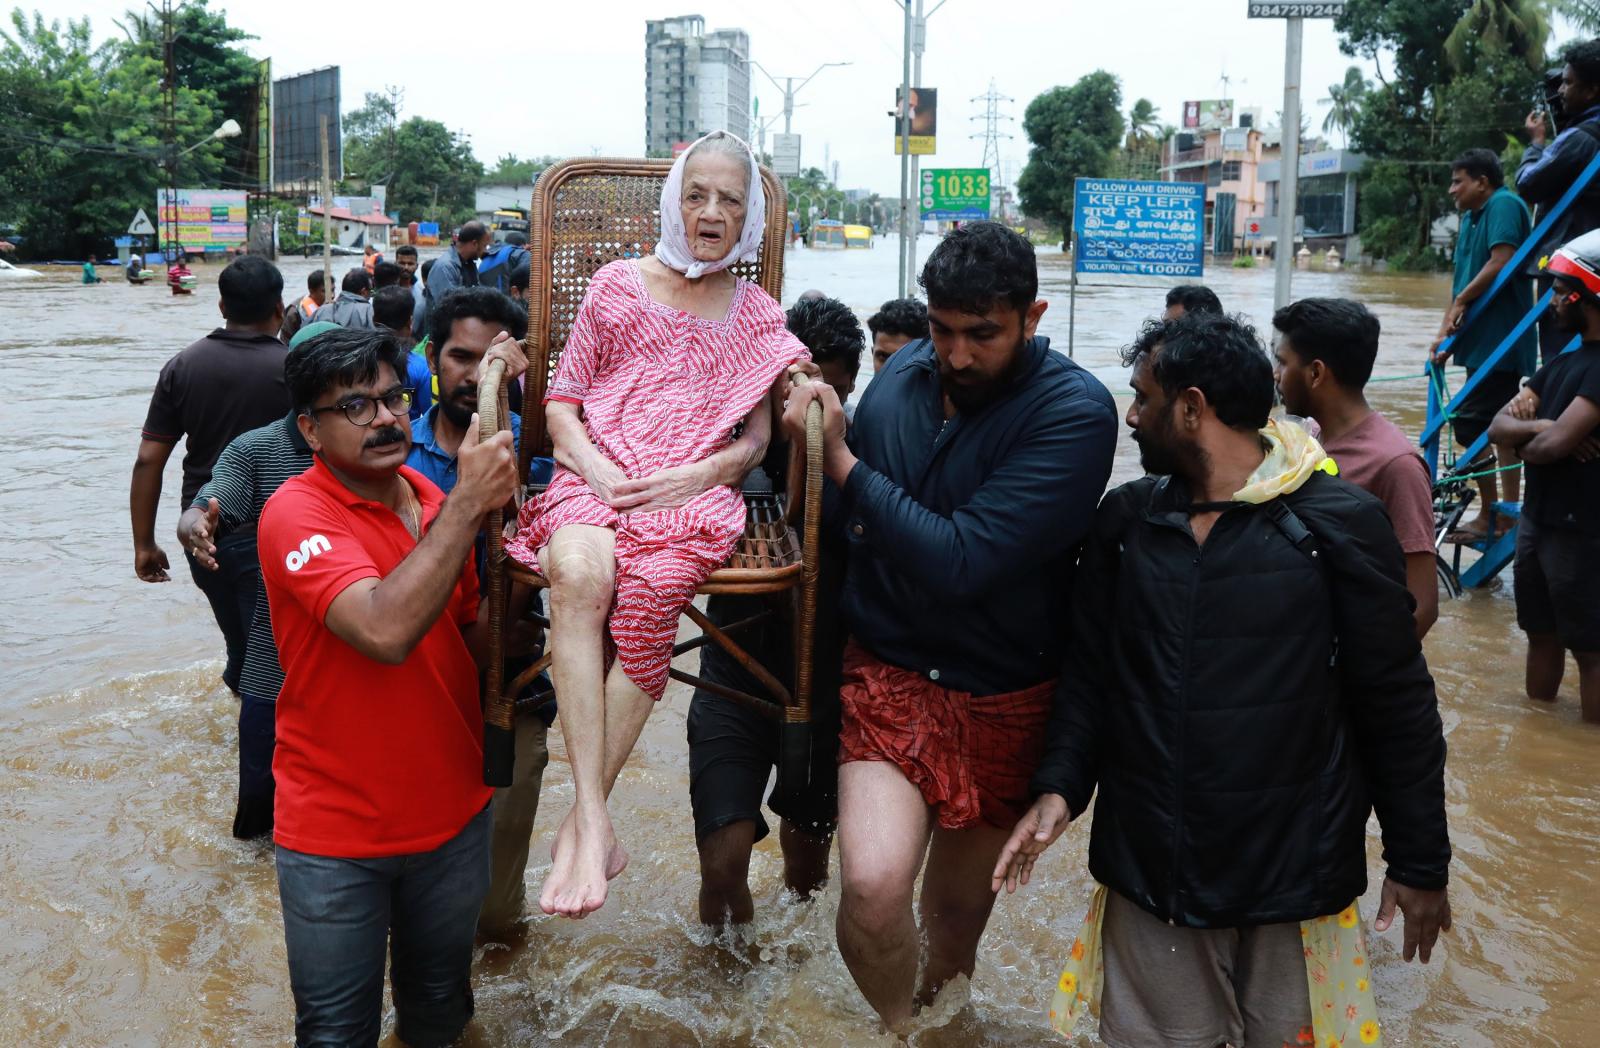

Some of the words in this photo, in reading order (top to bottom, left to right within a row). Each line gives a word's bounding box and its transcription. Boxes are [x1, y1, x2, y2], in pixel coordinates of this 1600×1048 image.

[1252, 4, 1343, 16] 9847219244
[937, 175, 988, 197] 1033
[1086, 183, 1127, 192] FOLLOW
[1129, 184, 1154, 193] LANE
[1157, 186, 1196, 195] DRIVING
[1089, 195, 1140, 206] KEEP
[1147, 198, 1192, 207] LEFT
[1085, 263, 1121, 272] VIOLATION
